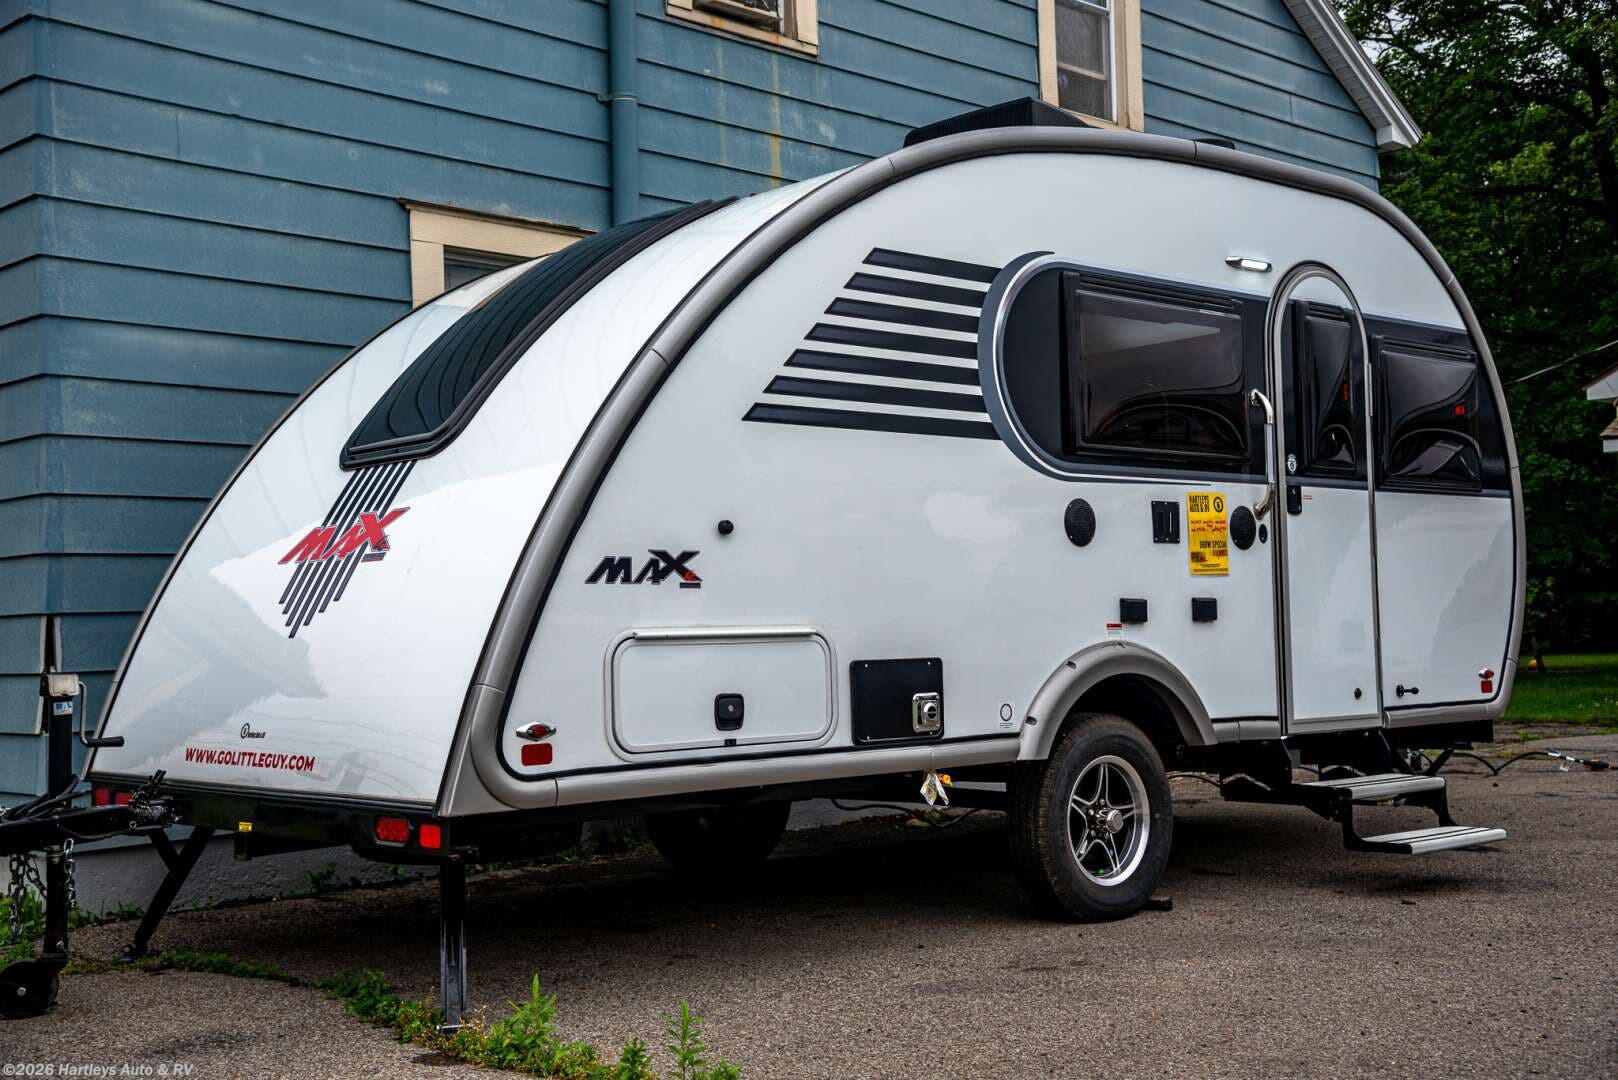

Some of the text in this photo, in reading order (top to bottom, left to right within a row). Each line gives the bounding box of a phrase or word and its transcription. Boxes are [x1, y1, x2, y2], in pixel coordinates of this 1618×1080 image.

[278, 506, 410, 565] MAX
[584, 548, 703, 585] MAX
[185, 747, 316, 771] WWW.GOLITTLEGUY.COM
